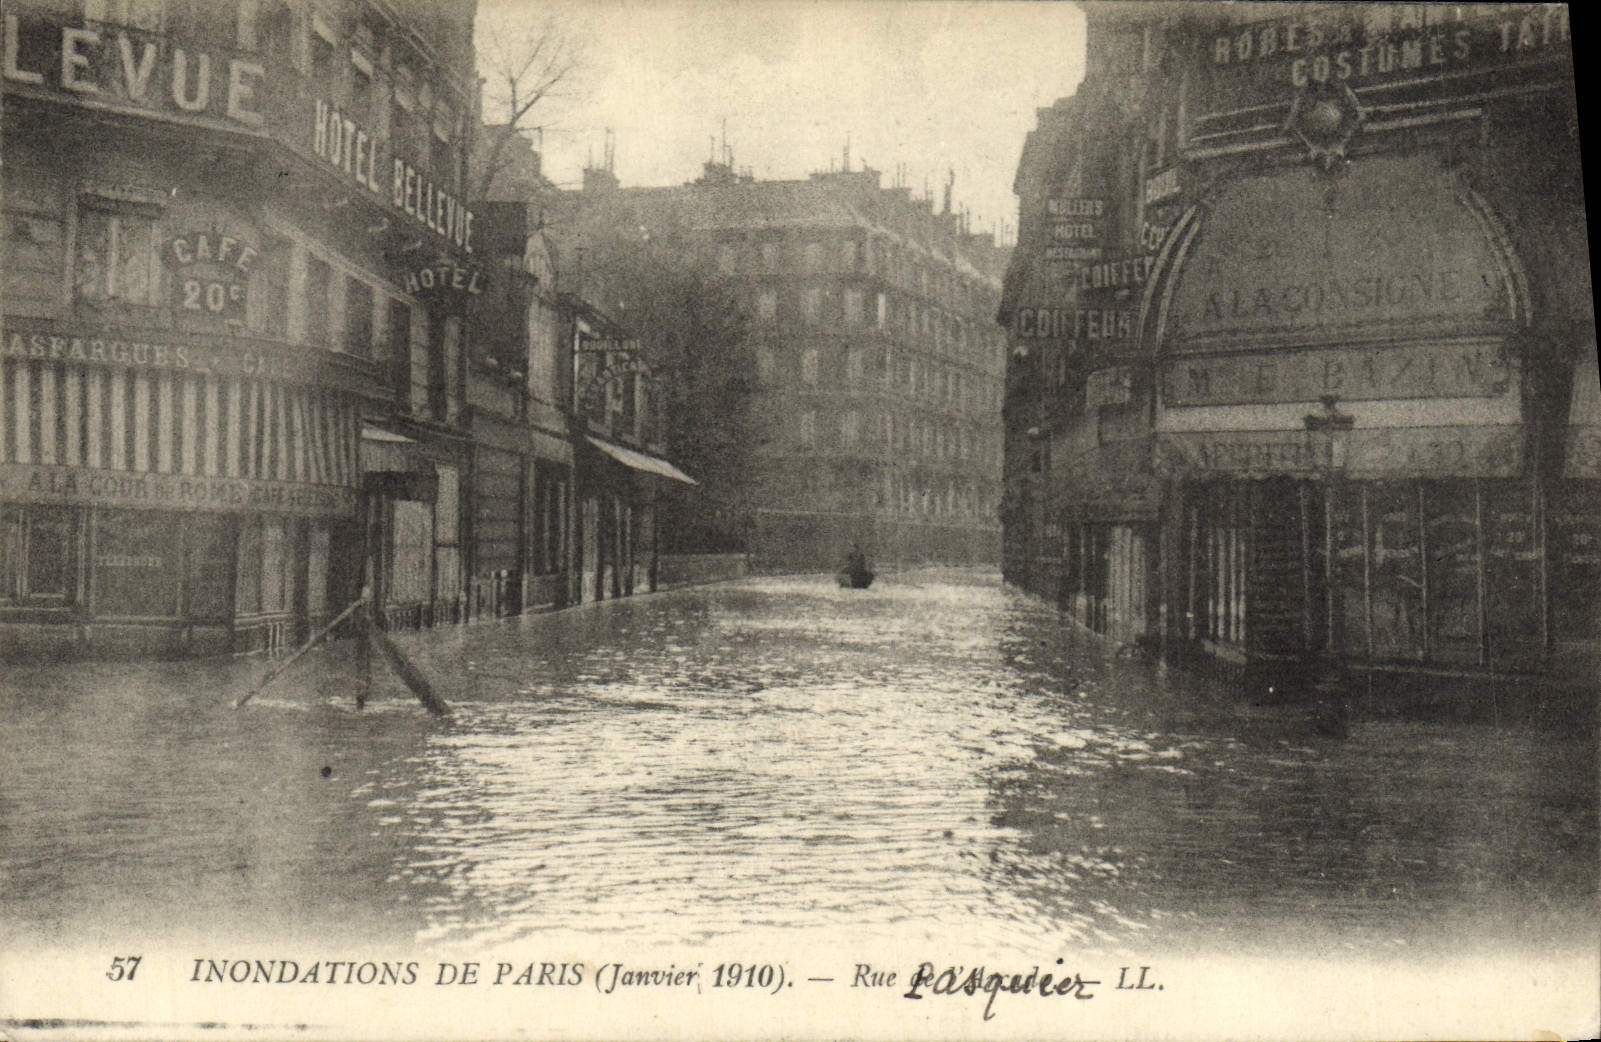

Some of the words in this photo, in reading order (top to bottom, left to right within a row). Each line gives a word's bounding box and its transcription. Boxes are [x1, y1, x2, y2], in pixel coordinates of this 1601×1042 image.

[1292, 31, 1471, 87] COSTUMES
[315, 99, 380, 193] HOTEL
[394, 157, 475, 254] BELLEVUE
[172, 234, 259, 272] CAFE
[404, 267, 482, 294] HOTEL
